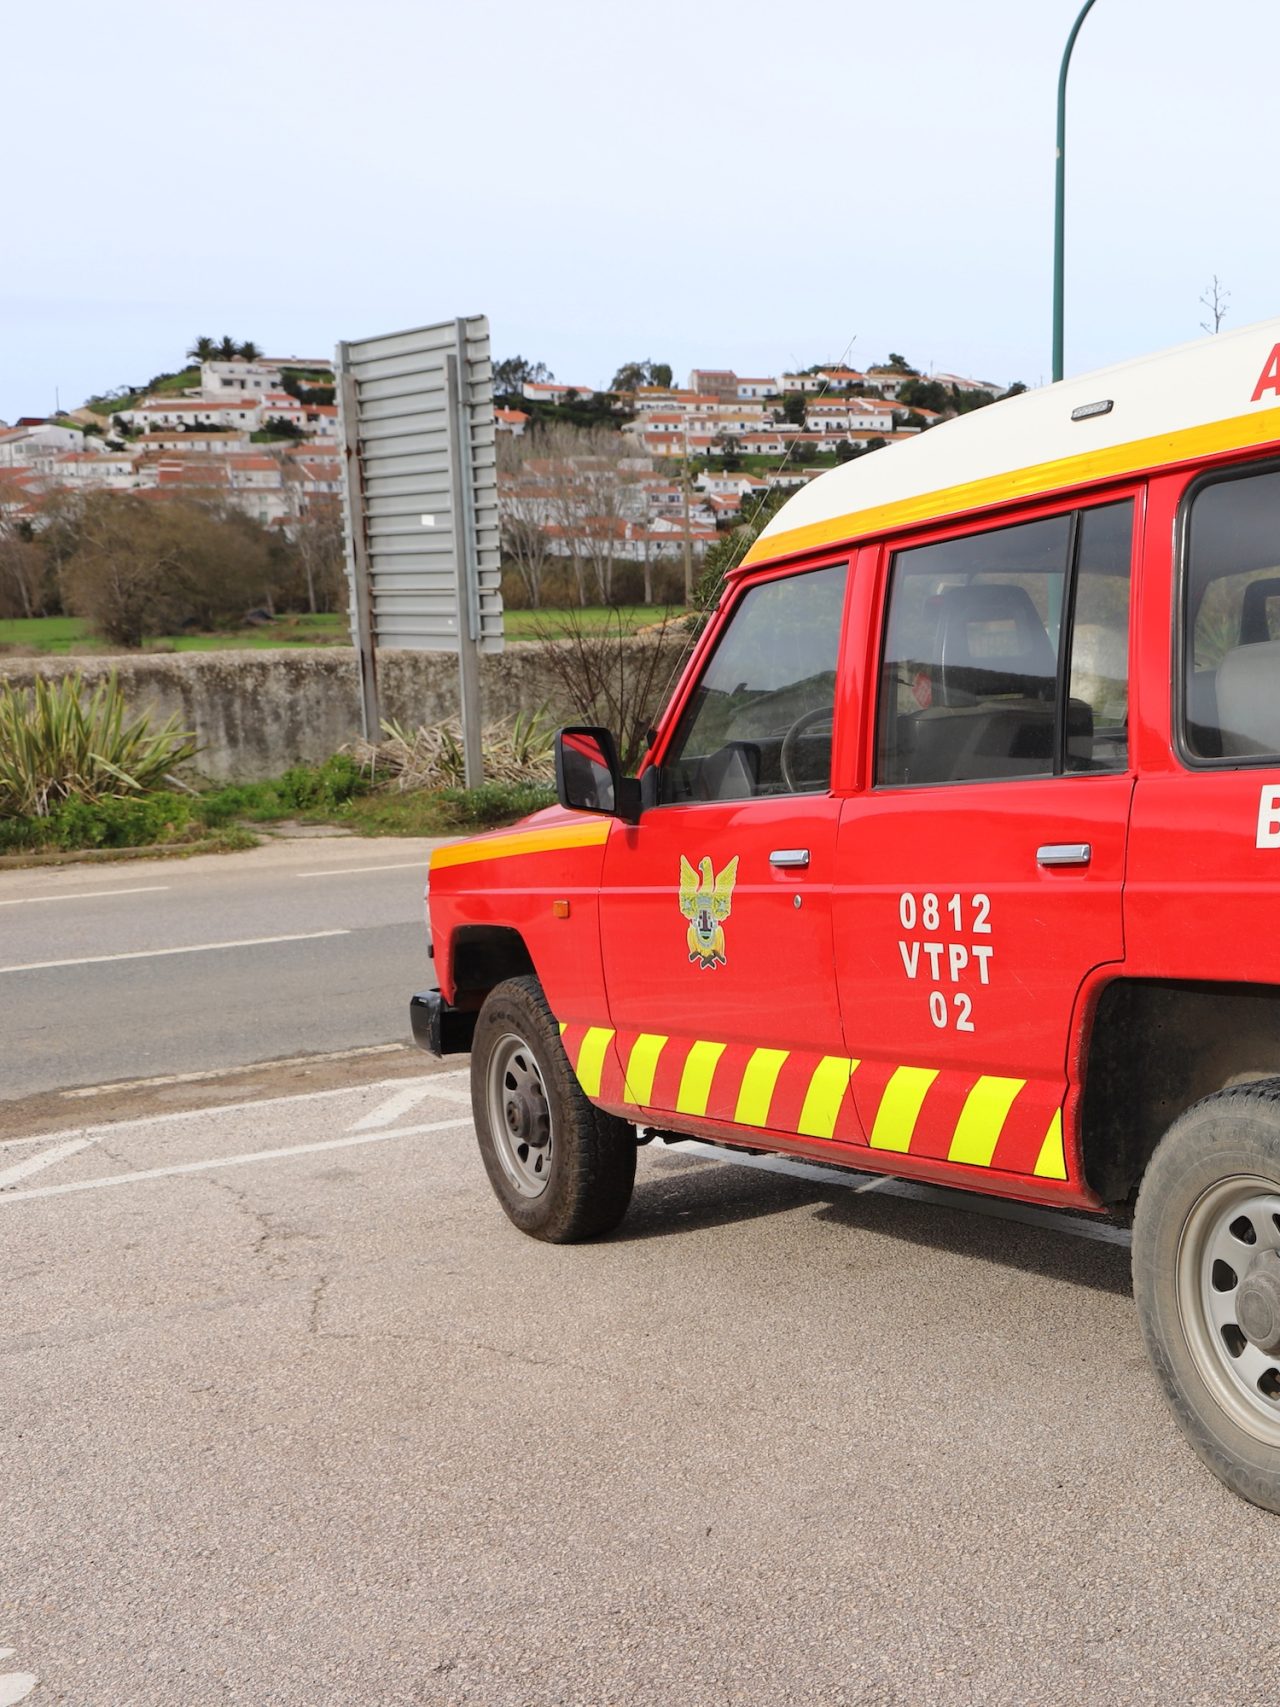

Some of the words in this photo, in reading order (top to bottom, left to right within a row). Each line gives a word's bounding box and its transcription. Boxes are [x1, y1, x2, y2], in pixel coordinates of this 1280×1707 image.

[899, 892, 992, 934] 0812
[898, 940, 994, 985] VTPT
[929, 990, 975, 1032] 02
